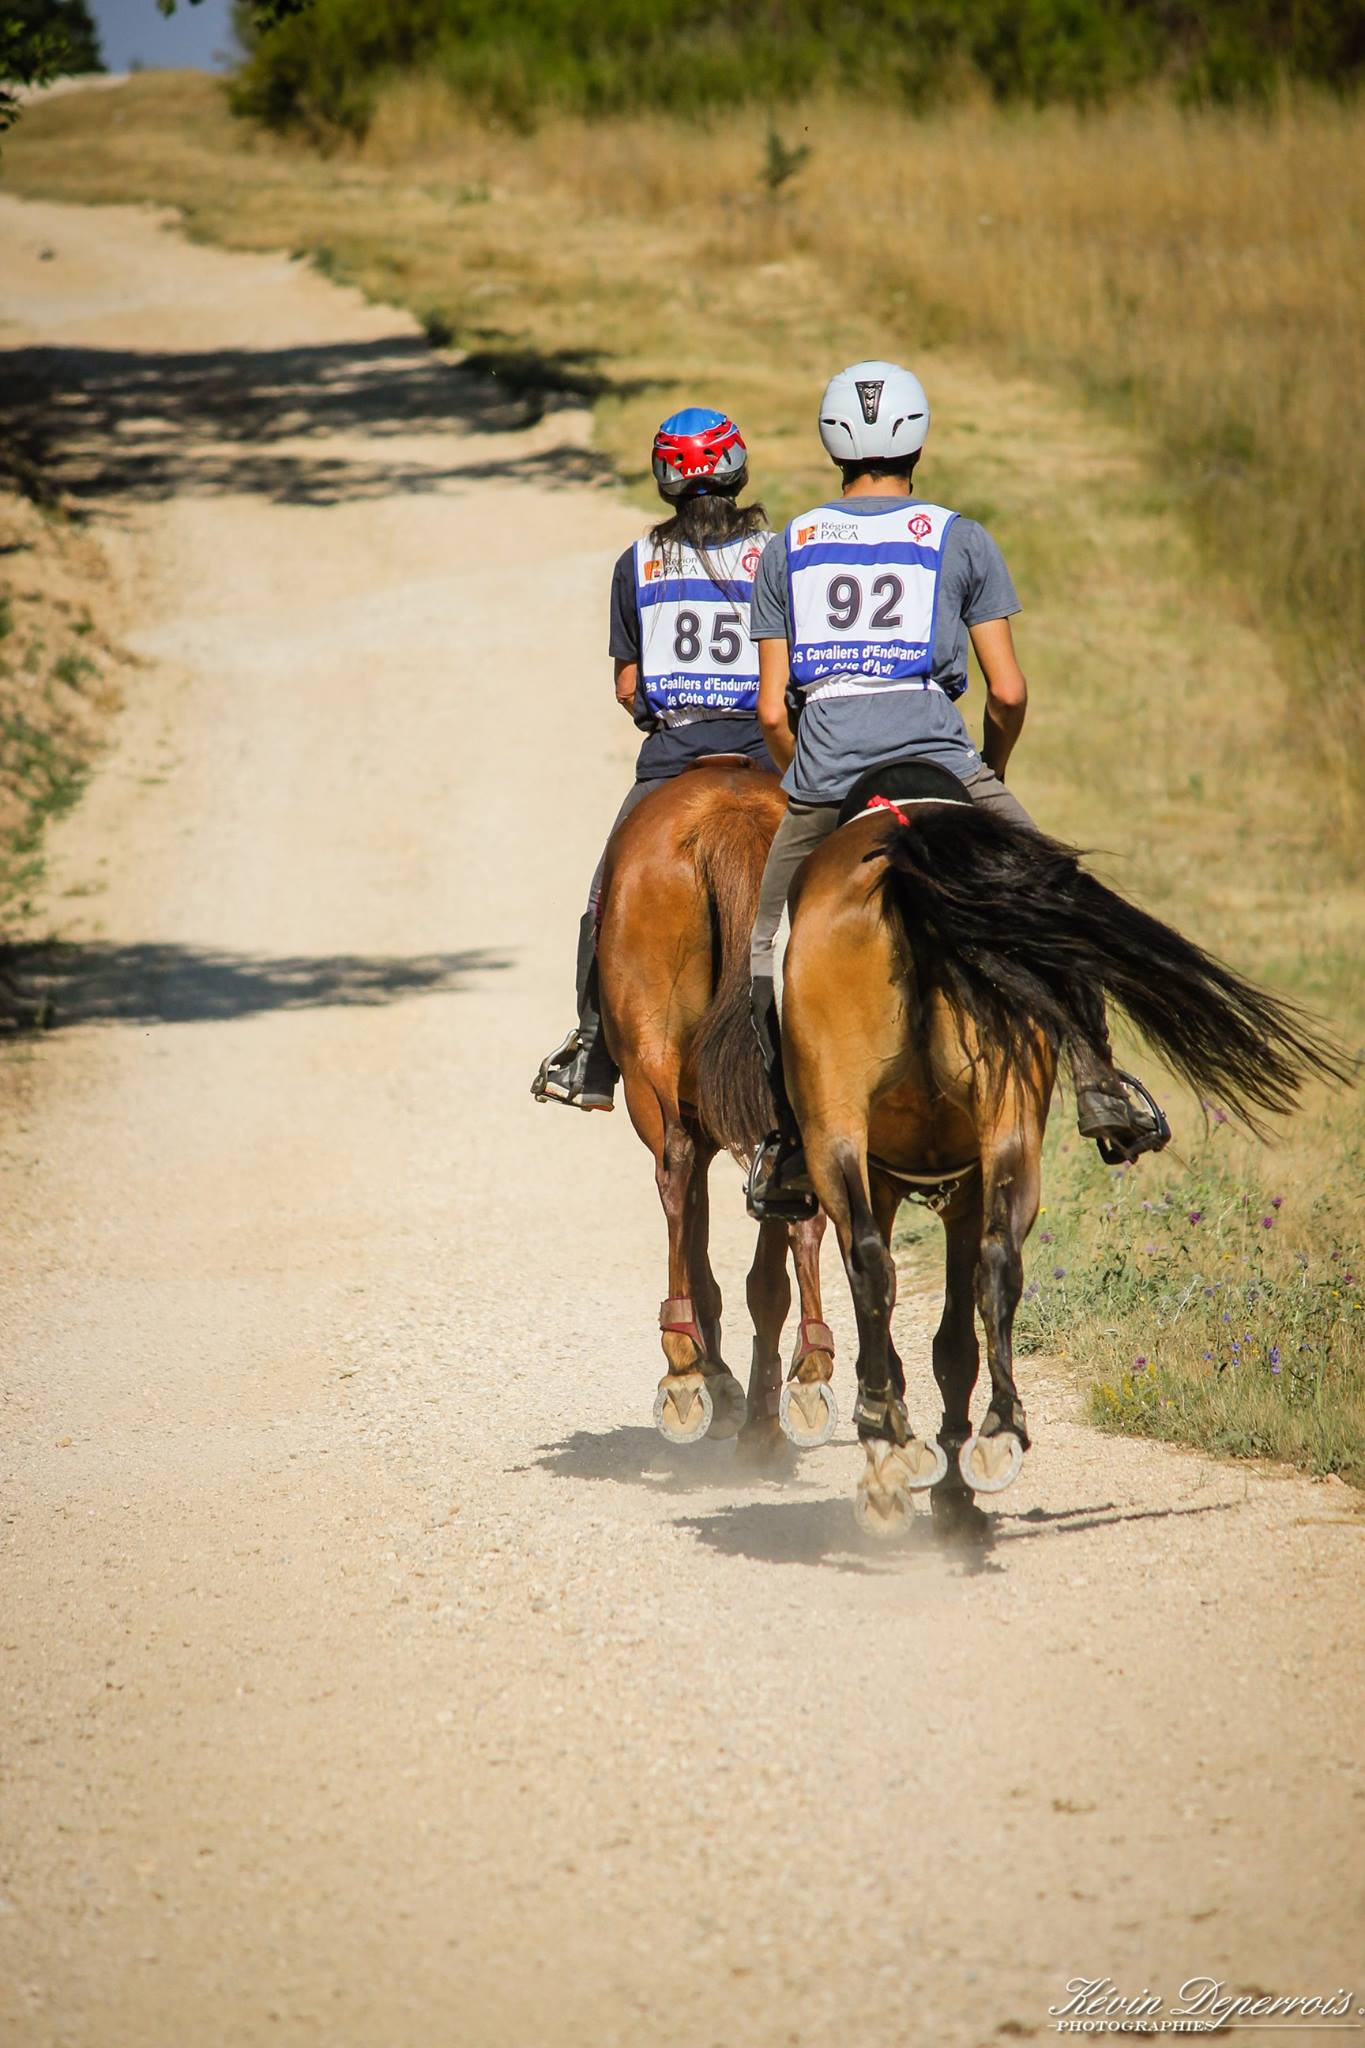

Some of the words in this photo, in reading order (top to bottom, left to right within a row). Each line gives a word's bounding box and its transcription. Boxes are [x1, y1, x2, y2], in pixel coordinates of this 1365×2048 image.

[821, 521, 858, 532] Région
[821, 530, 858, 540] PACA
[665, 556, 697, 567] Réion
[826, 572, 905, 631] 92
[673, 609, 742, 665] 85
[793, 651, 803, 663] es
[806, 645, 859, 661] Cavaliers
[646, 682, 657, 692] es
[660, 676, 701, 690] Caaliers
[679, 692, 704, 705] Côte
